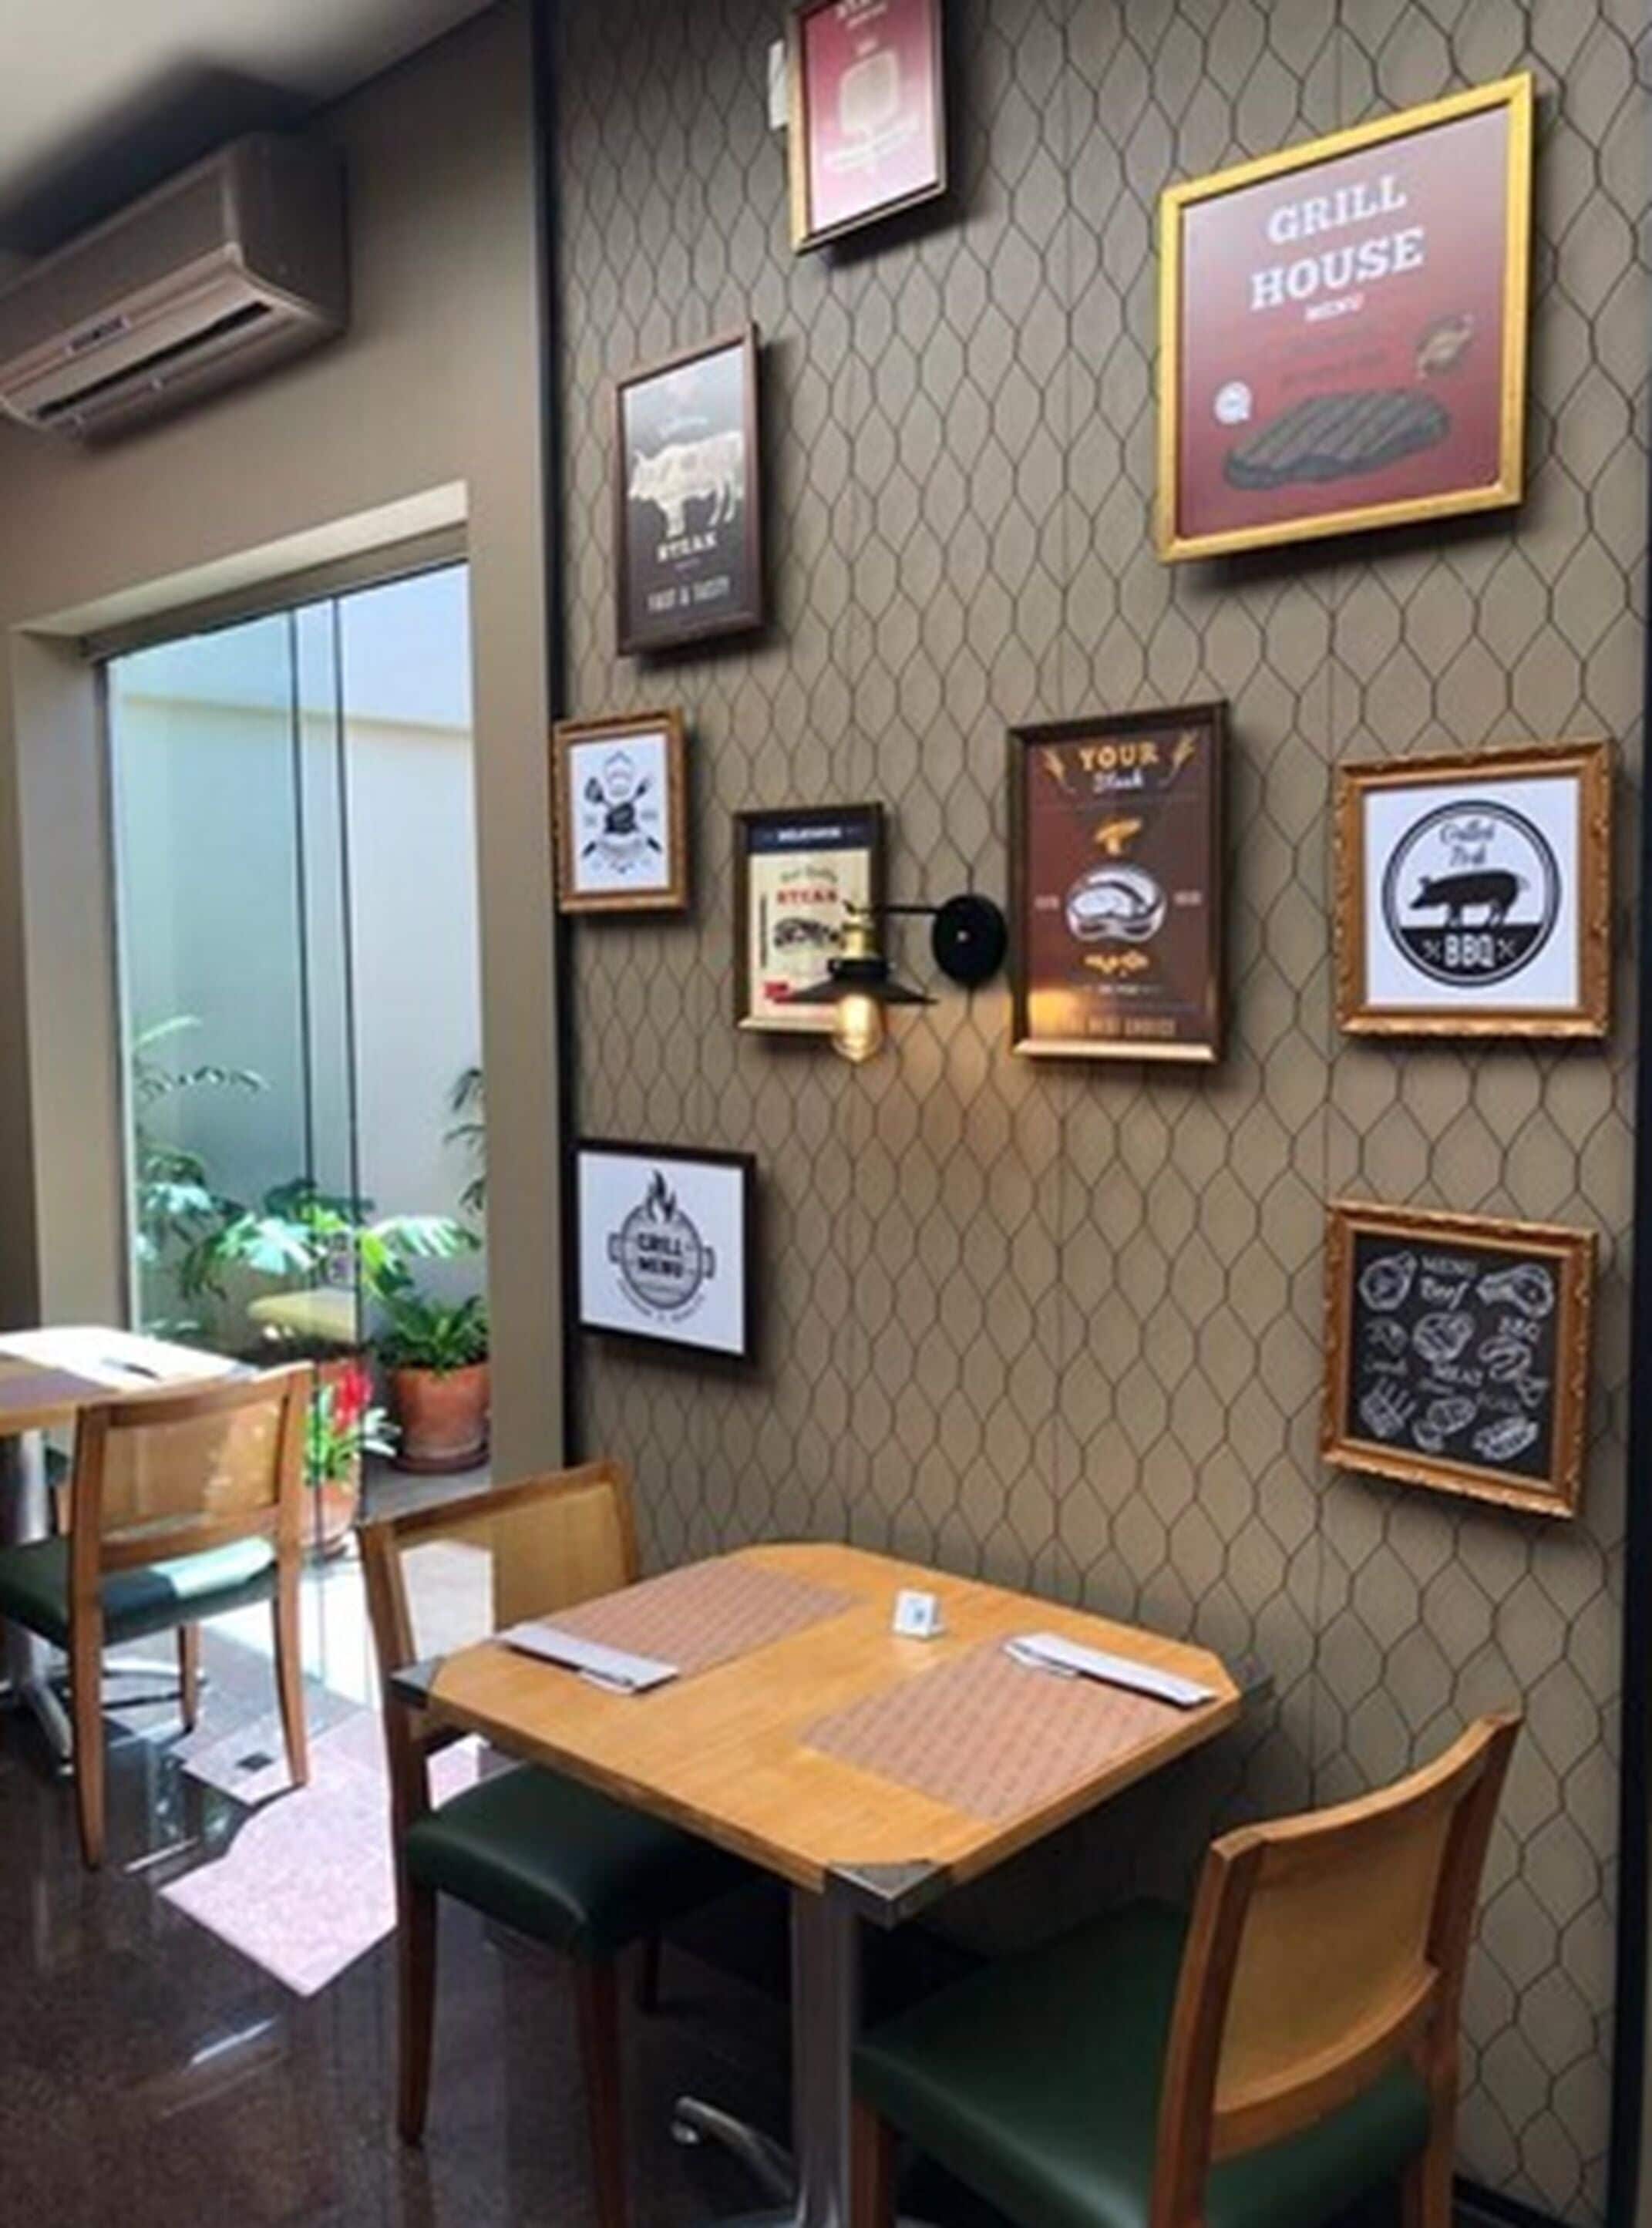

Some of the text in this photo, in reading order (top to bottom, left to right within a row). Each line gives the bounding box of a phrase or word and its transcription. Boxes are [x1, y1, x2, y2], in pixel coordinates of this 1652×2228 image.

[1270, 176, 1406, 244] GRILL
[1250, 227, 1425, 310] HOUSE
[658, 532, 716, 562] STEAK
[1080, 742, 1158, 771] YOUR
[1444, 934, 1494, 968] BBQ
[638, 1233, 681, 1256] GRILL
